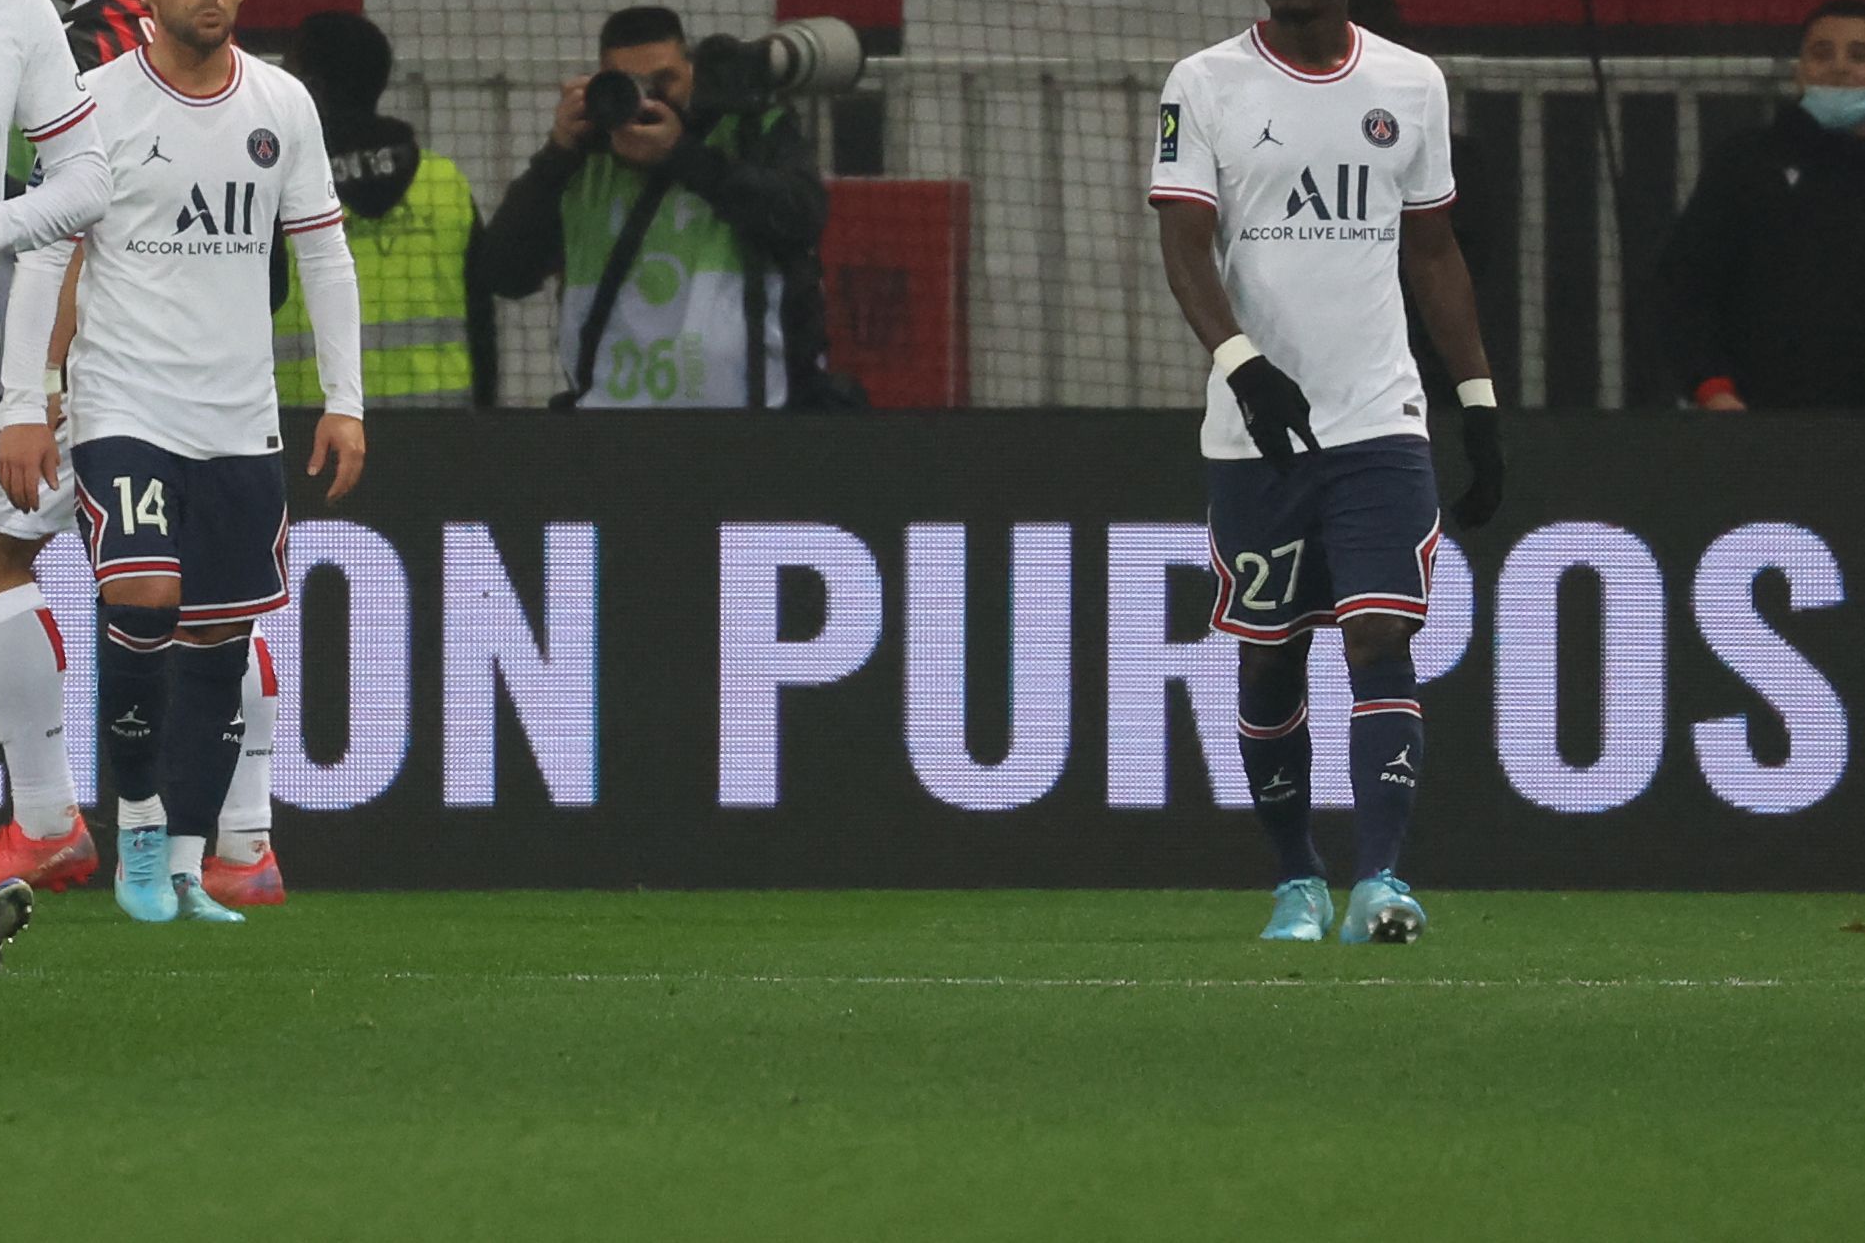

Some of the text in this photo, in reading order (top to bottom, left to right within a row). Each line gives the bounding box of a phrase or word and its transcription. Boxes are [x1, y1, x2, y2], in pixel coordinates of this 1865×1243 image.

[125, 239, 184, 255] ACCOR
[188, 241, 223, 255] LIVE
[1239, 226, 1294, 241] ACCOR
[1298, 227, 1336, 241] LIVE
[112, 476, 169, 536] 14
[1235, 538, 1305, 610] 27
[260, 519, 599, 810] ON
